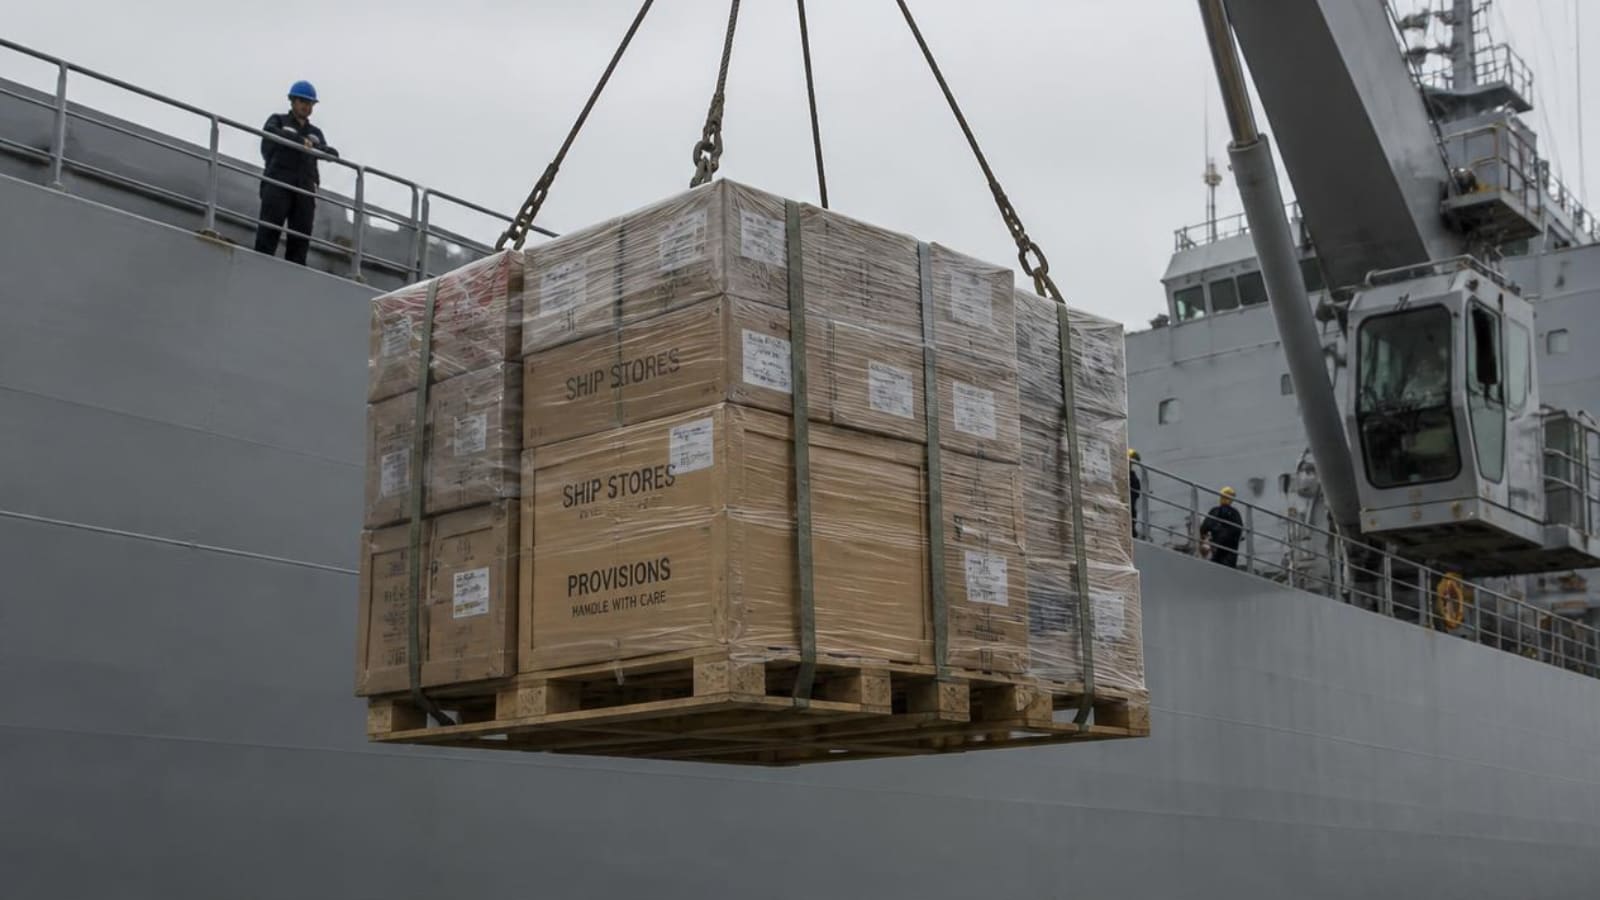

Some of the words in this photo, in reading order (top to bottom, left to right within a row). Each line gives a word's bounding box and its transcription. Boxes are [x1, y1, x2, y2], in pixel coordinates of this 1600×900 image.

[565, 369, 604, 400] SHIP
[610, 348, 680, 388] STORES
[563, 479, 602, 508] SHIP
[608, 464, 676, 499] STORES
[568, 557, 671, 598] PROVISIONS
[612, 595, 637, 611] WITH
[640, 591, 666, 607] CARE
